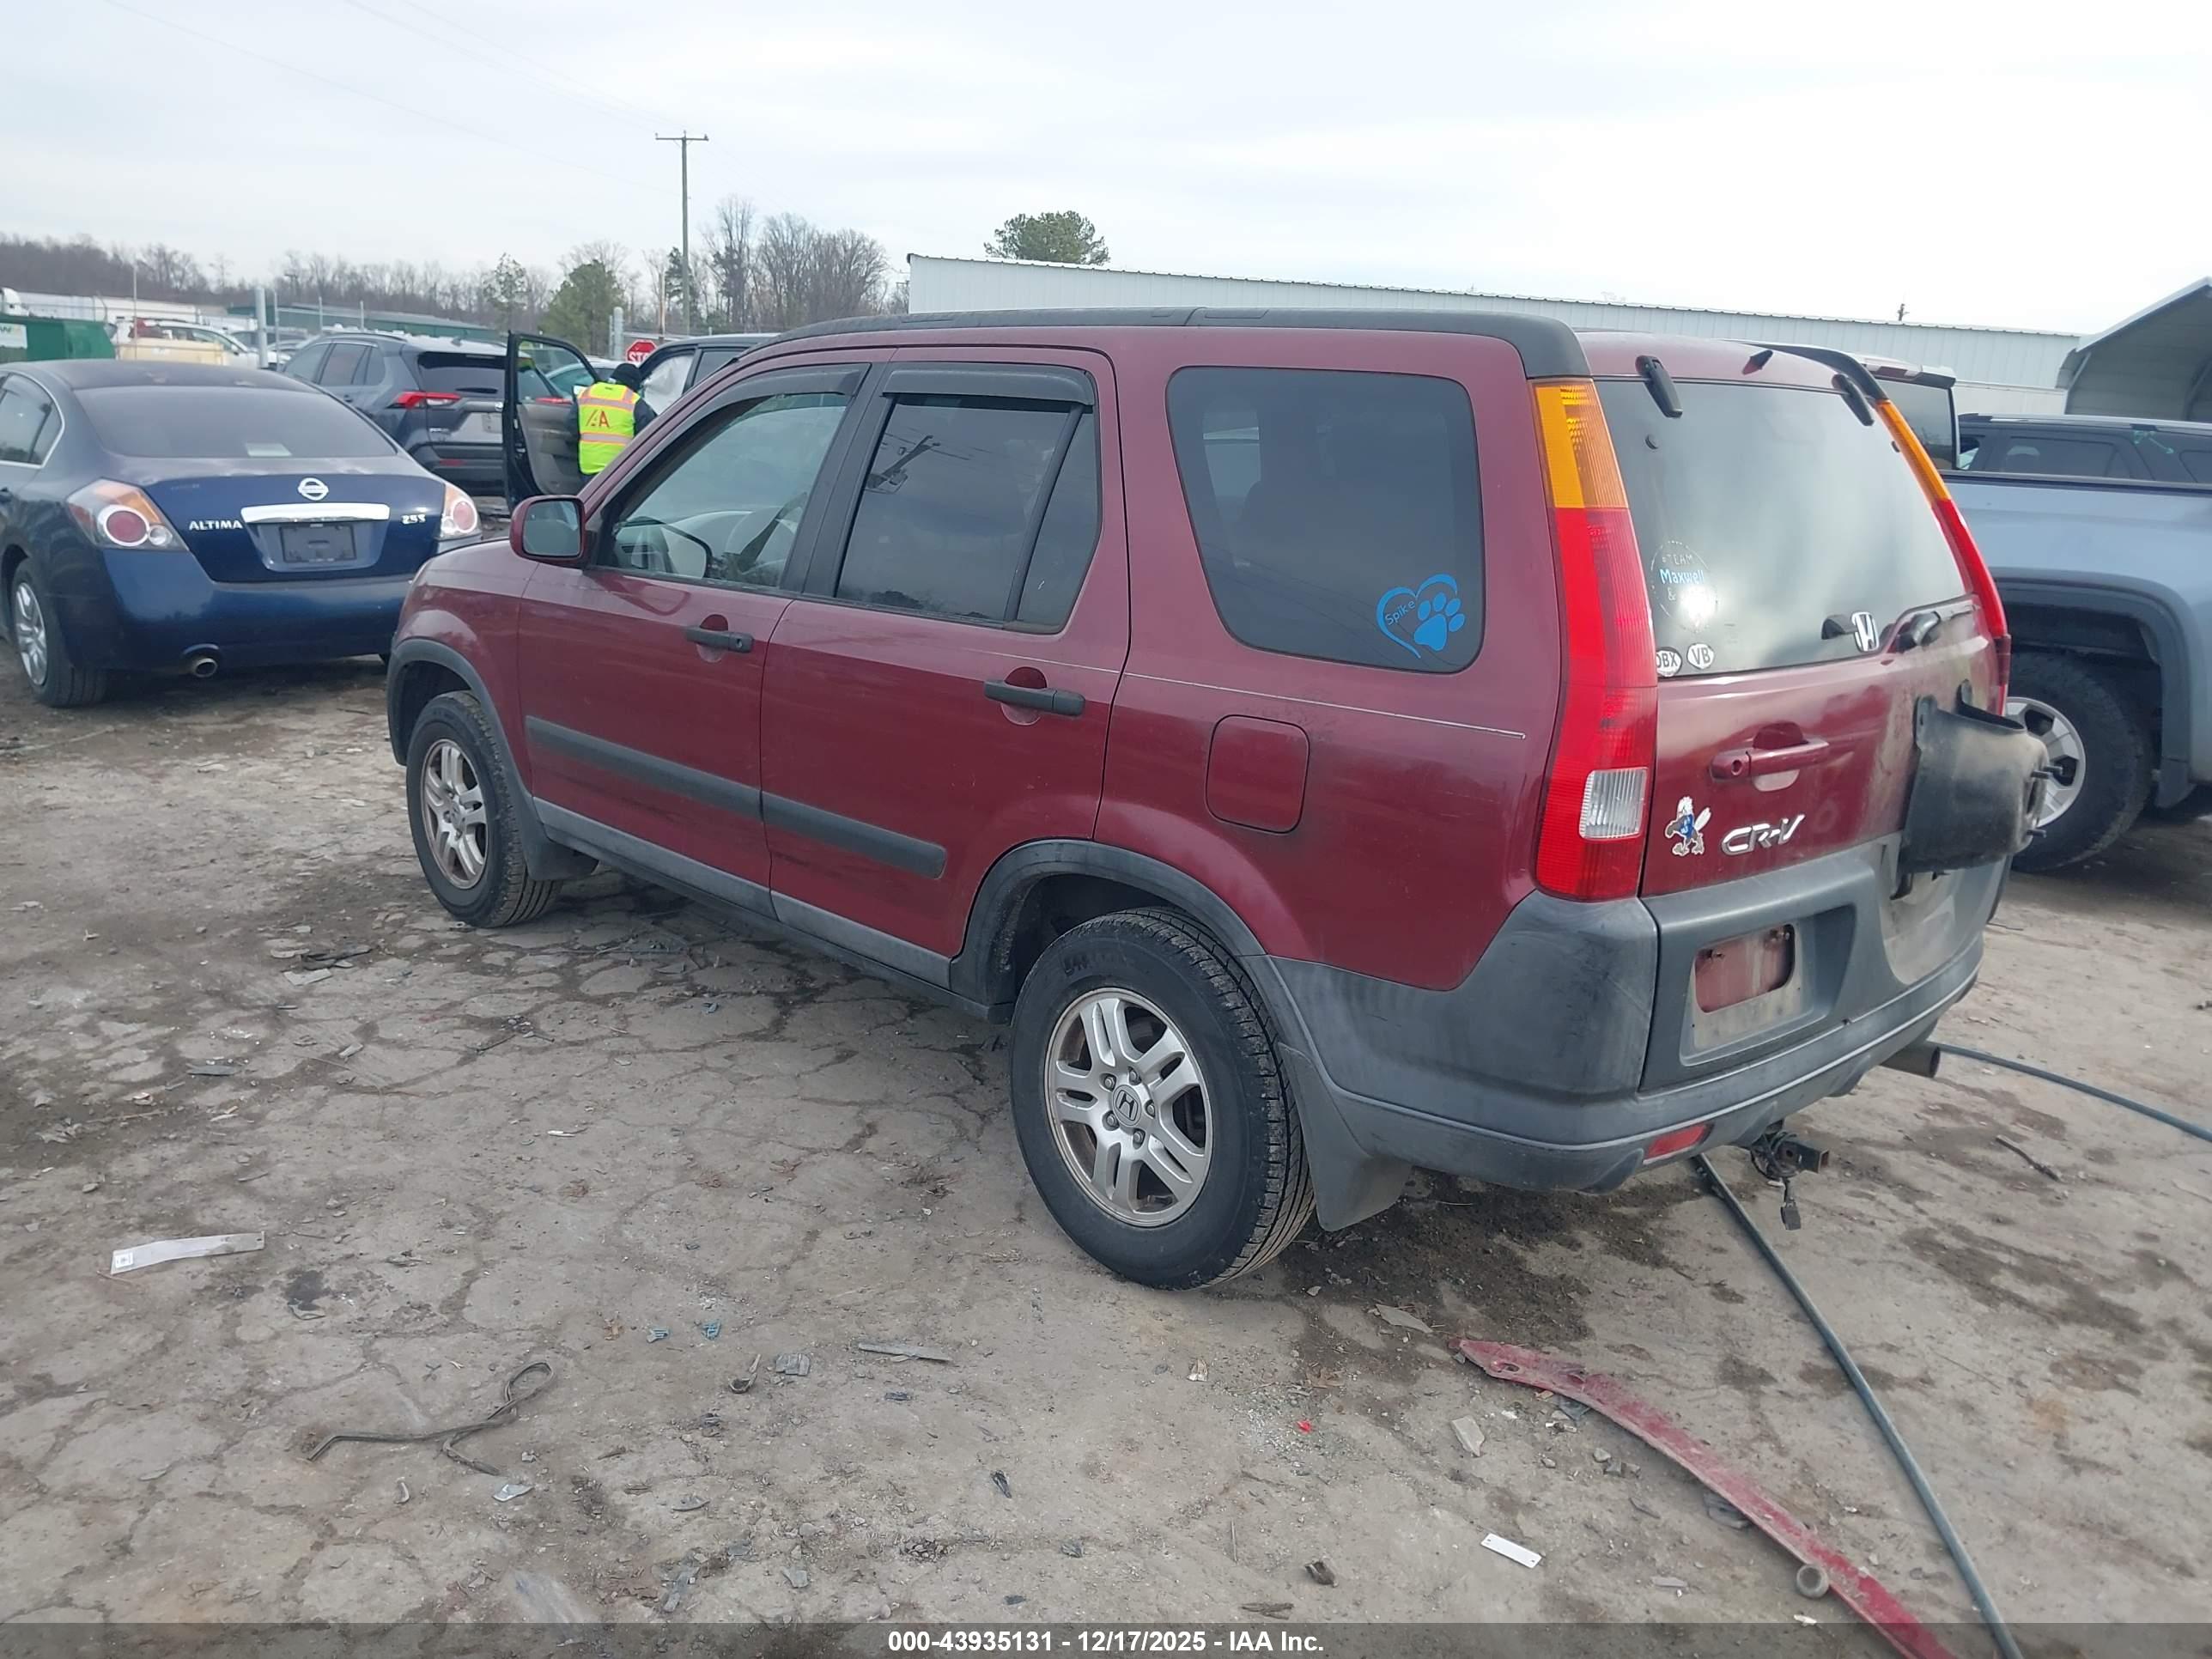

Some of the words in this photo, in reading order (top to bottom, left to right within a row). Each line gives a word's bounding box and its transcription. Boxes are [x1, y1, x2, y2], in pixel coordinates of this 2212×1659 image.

[188, 520, 243, 531] ALTIMA
[1659, 568, 1705, 585] Maxwell
[1385, 600, 1416, 626] Spike
[1692, 647, 1711, 665] VB
[1721, 814, 1805, 855] CR-V
